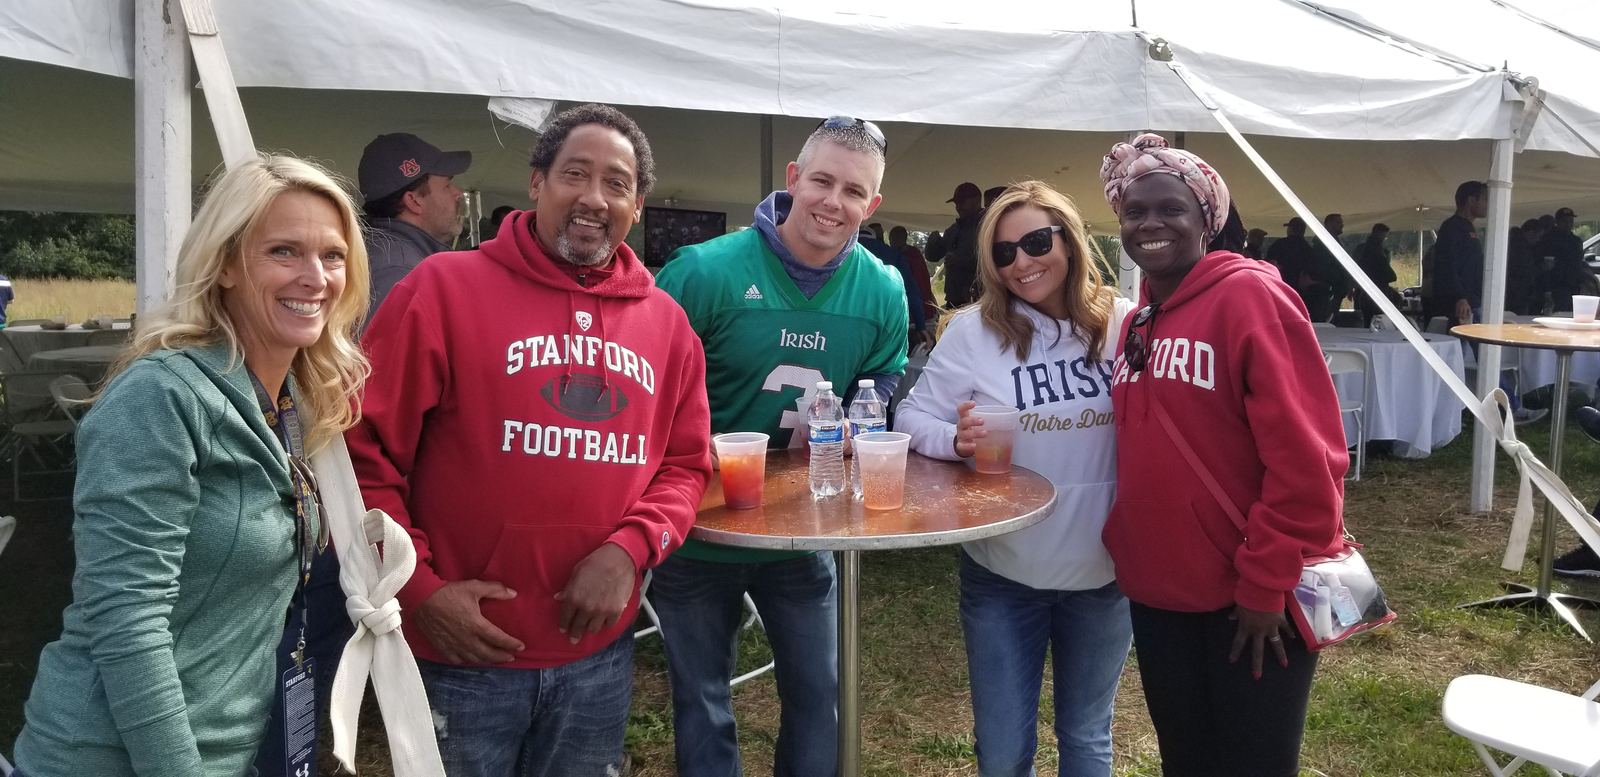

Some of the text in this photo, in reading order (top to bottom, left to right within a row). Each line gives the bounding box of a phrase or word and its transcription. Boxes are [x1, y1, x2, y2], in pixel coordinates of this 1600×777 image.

[506, 334, 655, 395] STANFORD
[502, 419, 648, 464] FOOTBALL
[1019, 412, 1073, 434] Notre
